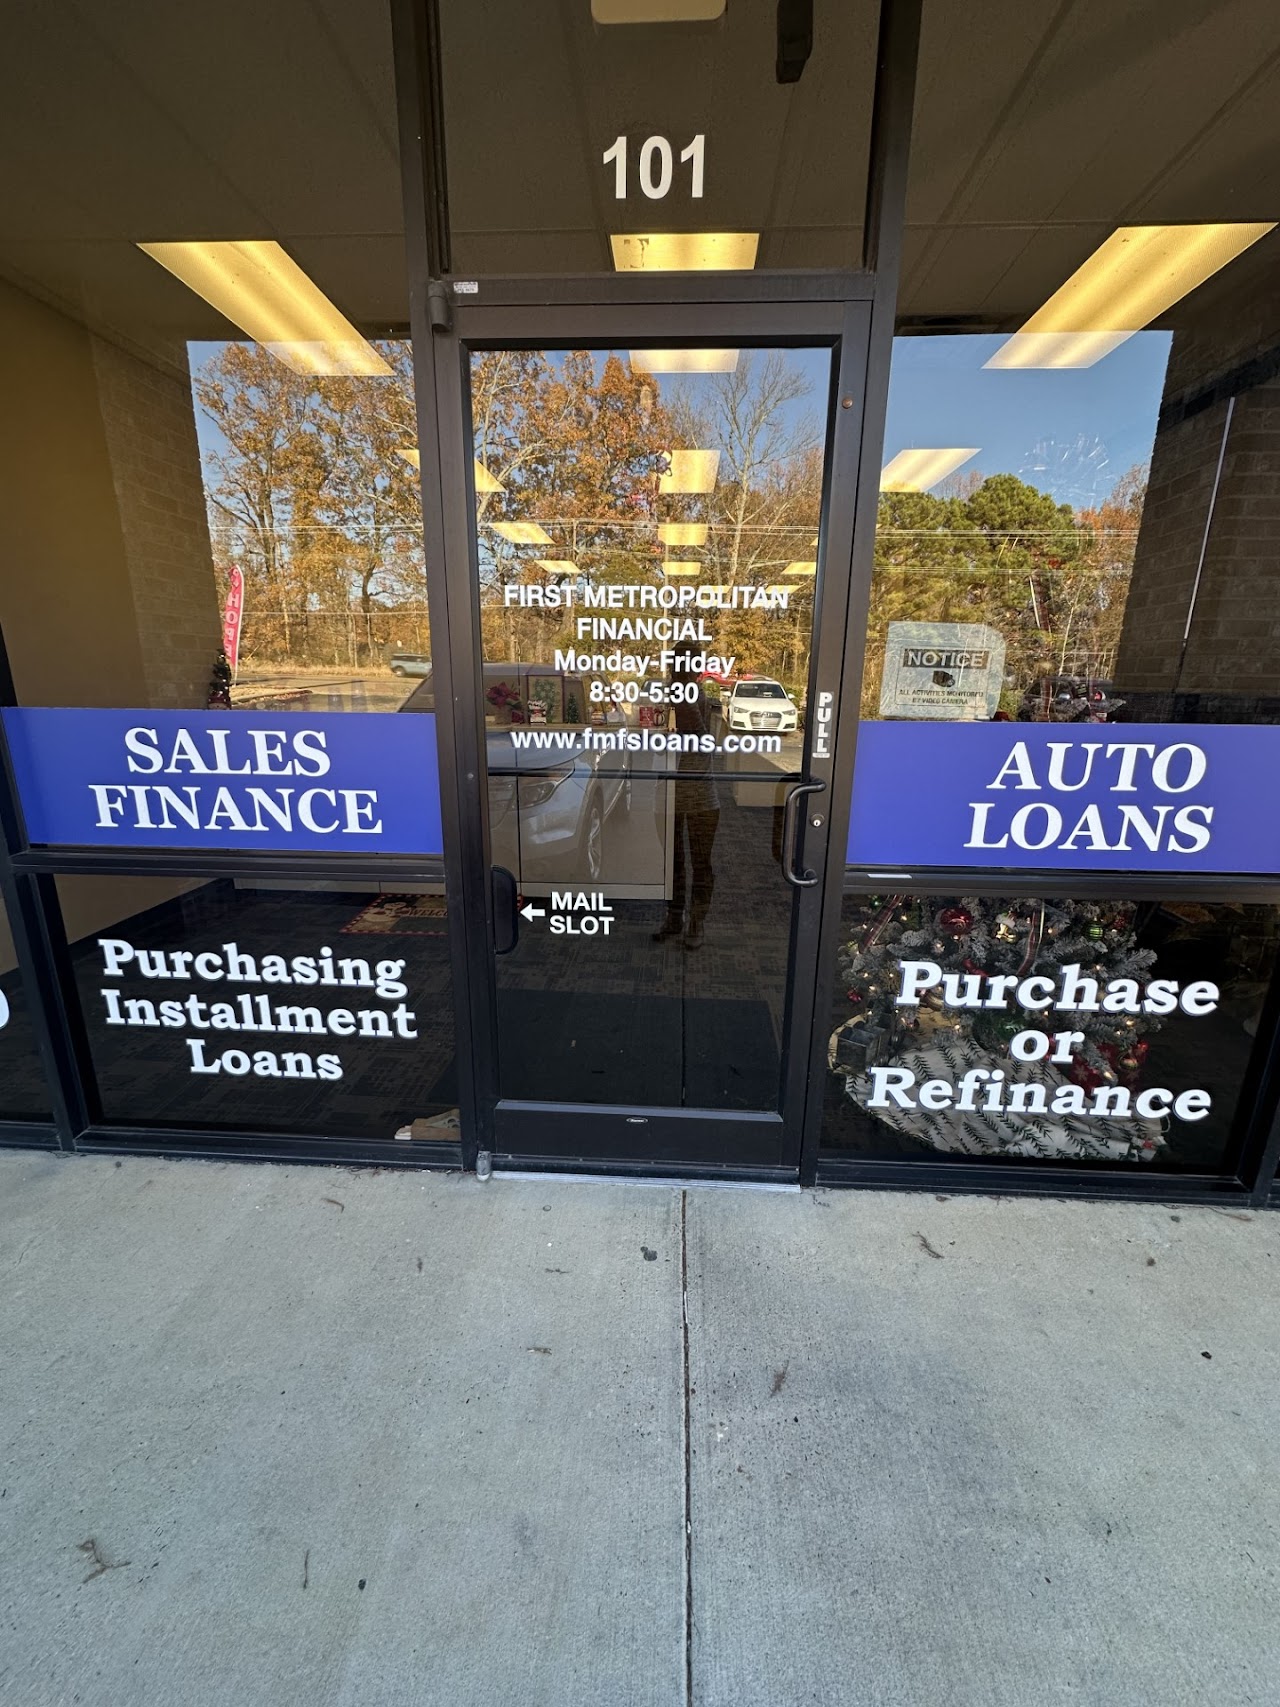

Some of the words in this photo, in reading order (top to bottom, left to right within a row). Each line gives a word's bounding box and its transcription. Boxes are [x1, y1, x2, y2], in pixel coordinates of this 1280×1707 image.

[603, 135, 705, 200] 101
[503, 585, 577, 608] FIRST
[584, 585, 789, 610] METROPOLITAN
[577, 617, 712, 641] FINANCIAL
[554, 649, 735, 678] Monday-Friday
[907, 651, 984, 667] NOTICE
[589, 681, 699, 706] 8:30-5:30
[511, 728, 782, 754] www.fmfsloans.com
[816, 691, 833, 753] PULL
[124, 727, 331, 777] SALES
[986, 741, 1207, 793] AUTO
[89, 785, 383, 834] FINANCE
[963, 803, 1214, 854] LOANS
[551, 891, 613, 911] MAIL
[549, 915, 615, 935] SLOT
[97, 938, 409, 999] Purchasing
[895, 960, 1220, 1017] Purchase
[101, 988, 418, 1039] Installment
[186, 1038, 344, 1081] Loans
[1010, 1029, 1085, 1064] or
[867, 1066, 1212, 1122] Refinance
